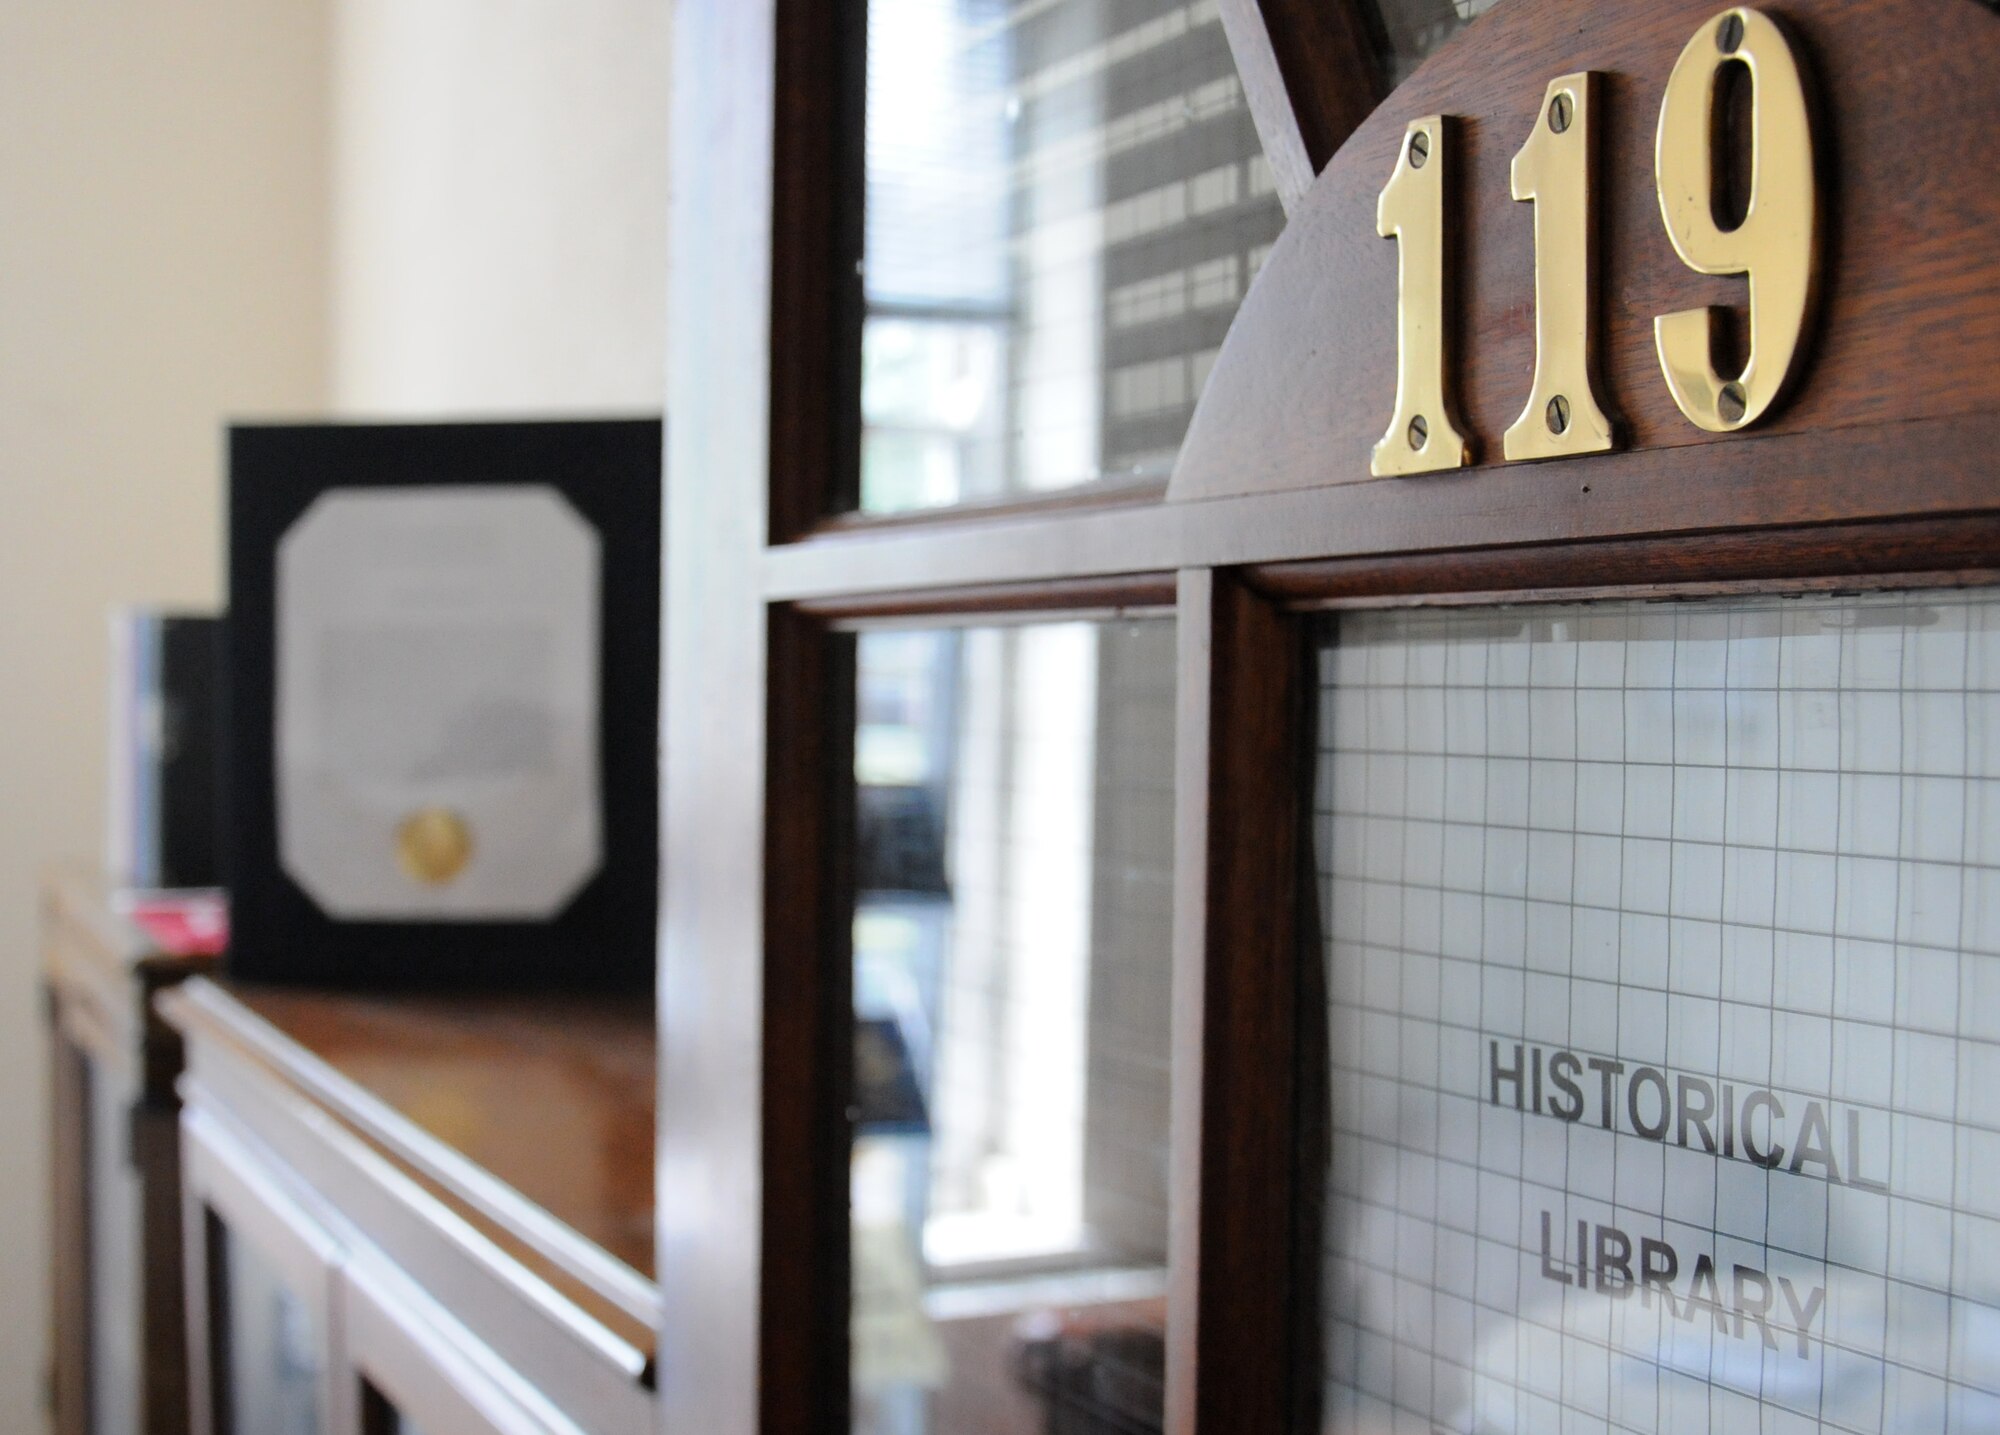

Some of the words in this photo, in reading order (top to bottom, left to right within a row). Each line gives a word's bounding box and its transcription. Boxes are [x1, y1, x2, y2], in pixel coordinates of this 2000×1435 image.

[1371, 7, 1816, 476] 119
[1489, 1041, 1889, 1196] HISTORICAL
[1541, 1210, 1827, 1361] LIBRARY
